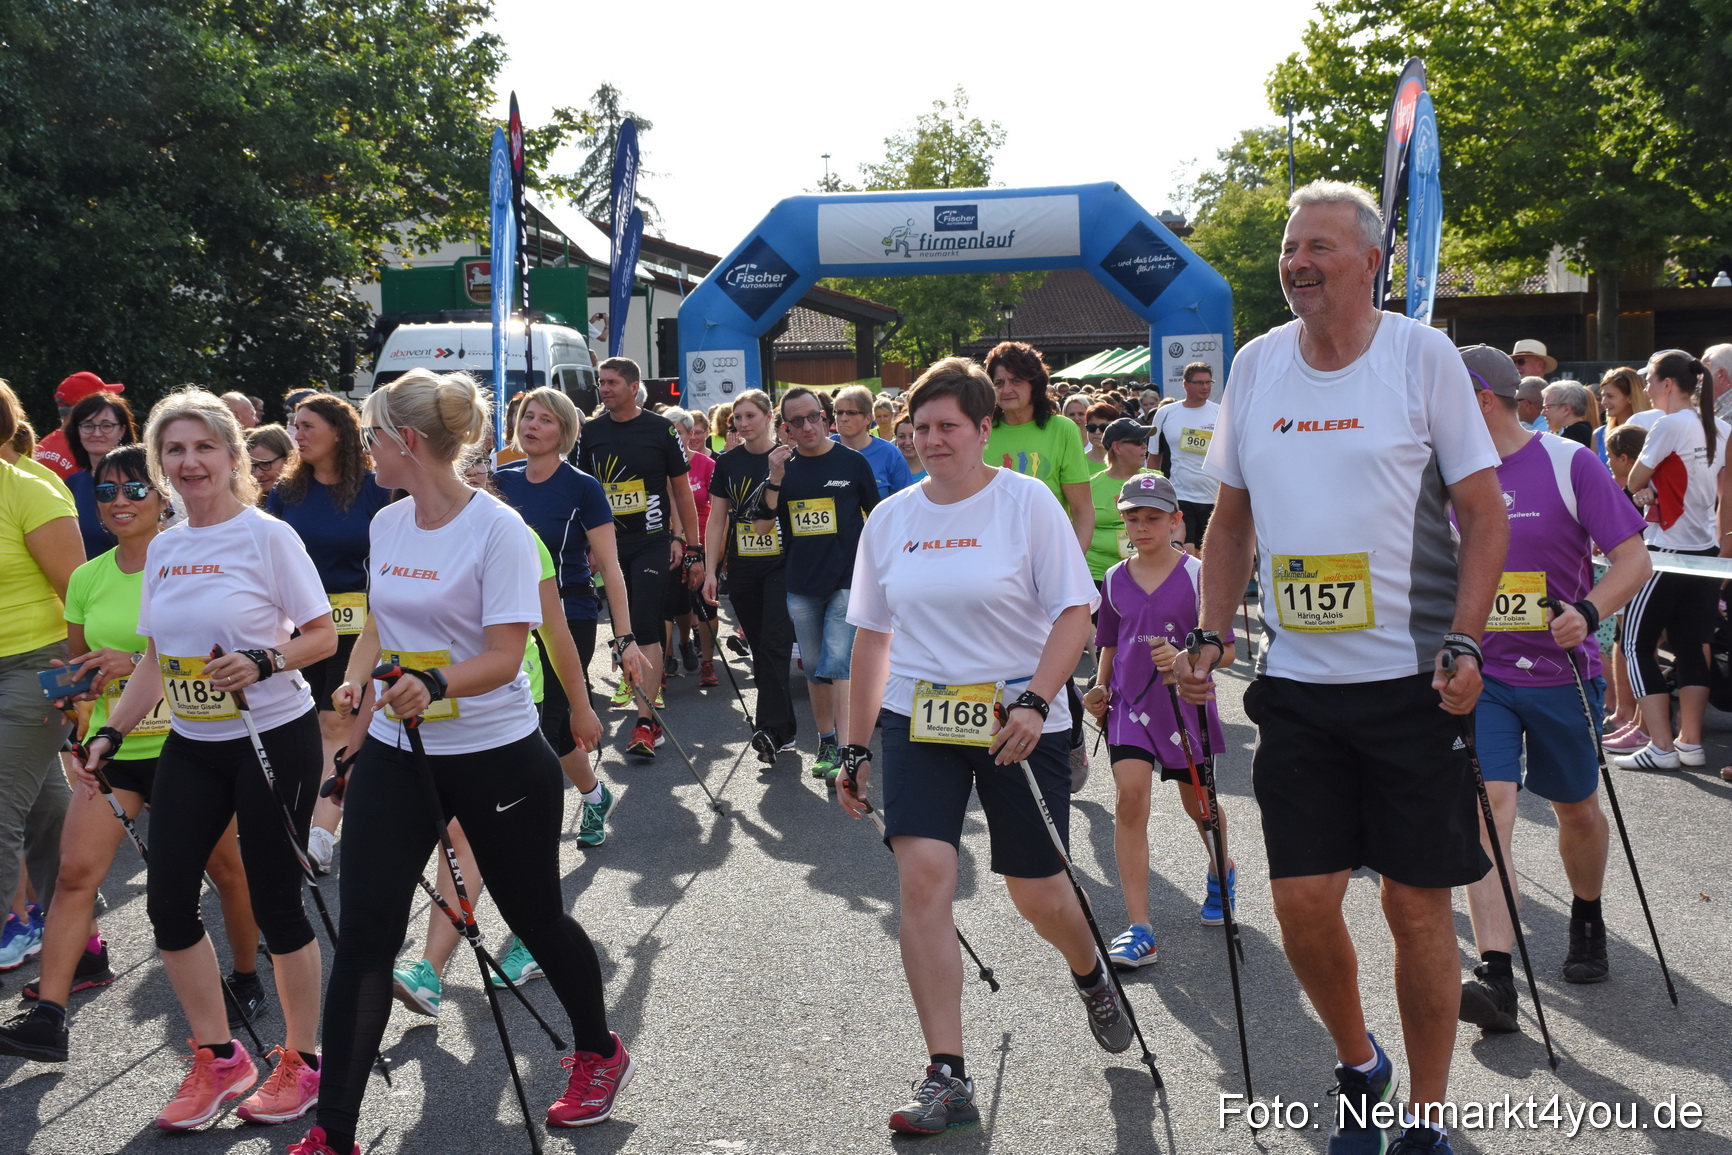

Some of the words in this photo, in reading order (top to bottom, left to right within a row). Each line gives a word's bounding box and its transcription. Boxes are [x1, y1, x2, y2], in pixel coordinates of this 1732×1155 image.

[944, 213, 976, 222] Fischer
[919, 230, 1016, 250] firmenlauf
[1118, 258, 1132, 267] und
[1133, 256, 1147, 264] das
[736, 271, 787, 284] Fischer
[389, 348, 432, 359] abavent
[1297, 418, 1365, 432] KLEBL
[1187, 436, 1206, 447] 960
[60, 458, 73, 470] SV
[609, 492, 639, 506] 1751
[795, 511, 830, 526] 1436
[742, 535, 773, 547] 1748
[922, 538, 983, 550] KLEBL
[172, 565, 225, 576] KLEBL
[391, 566, 440, 581] KLEBL
[1284, 570, 1319, 579] firmenlauf
[1284, 582, 1356, 611] 1157
[1297, 612, 1321, 620] Häring
[169, 679, 226, 703] 1185
[925, 687, 960, 697] firmenlauf
[176, 702, 200, 710] Schuster
[922, 699, 988, 727] 1168
[926, 725, 954, 733] Mederer
[954, 726, 980, 735] Sandra
[1203, 756, 1215, 793] EASY
[1208, 799, 1219, 830] WAY
[446, 847, 465, 886] LEKI
[421, 878, 444, 903] LEKI
